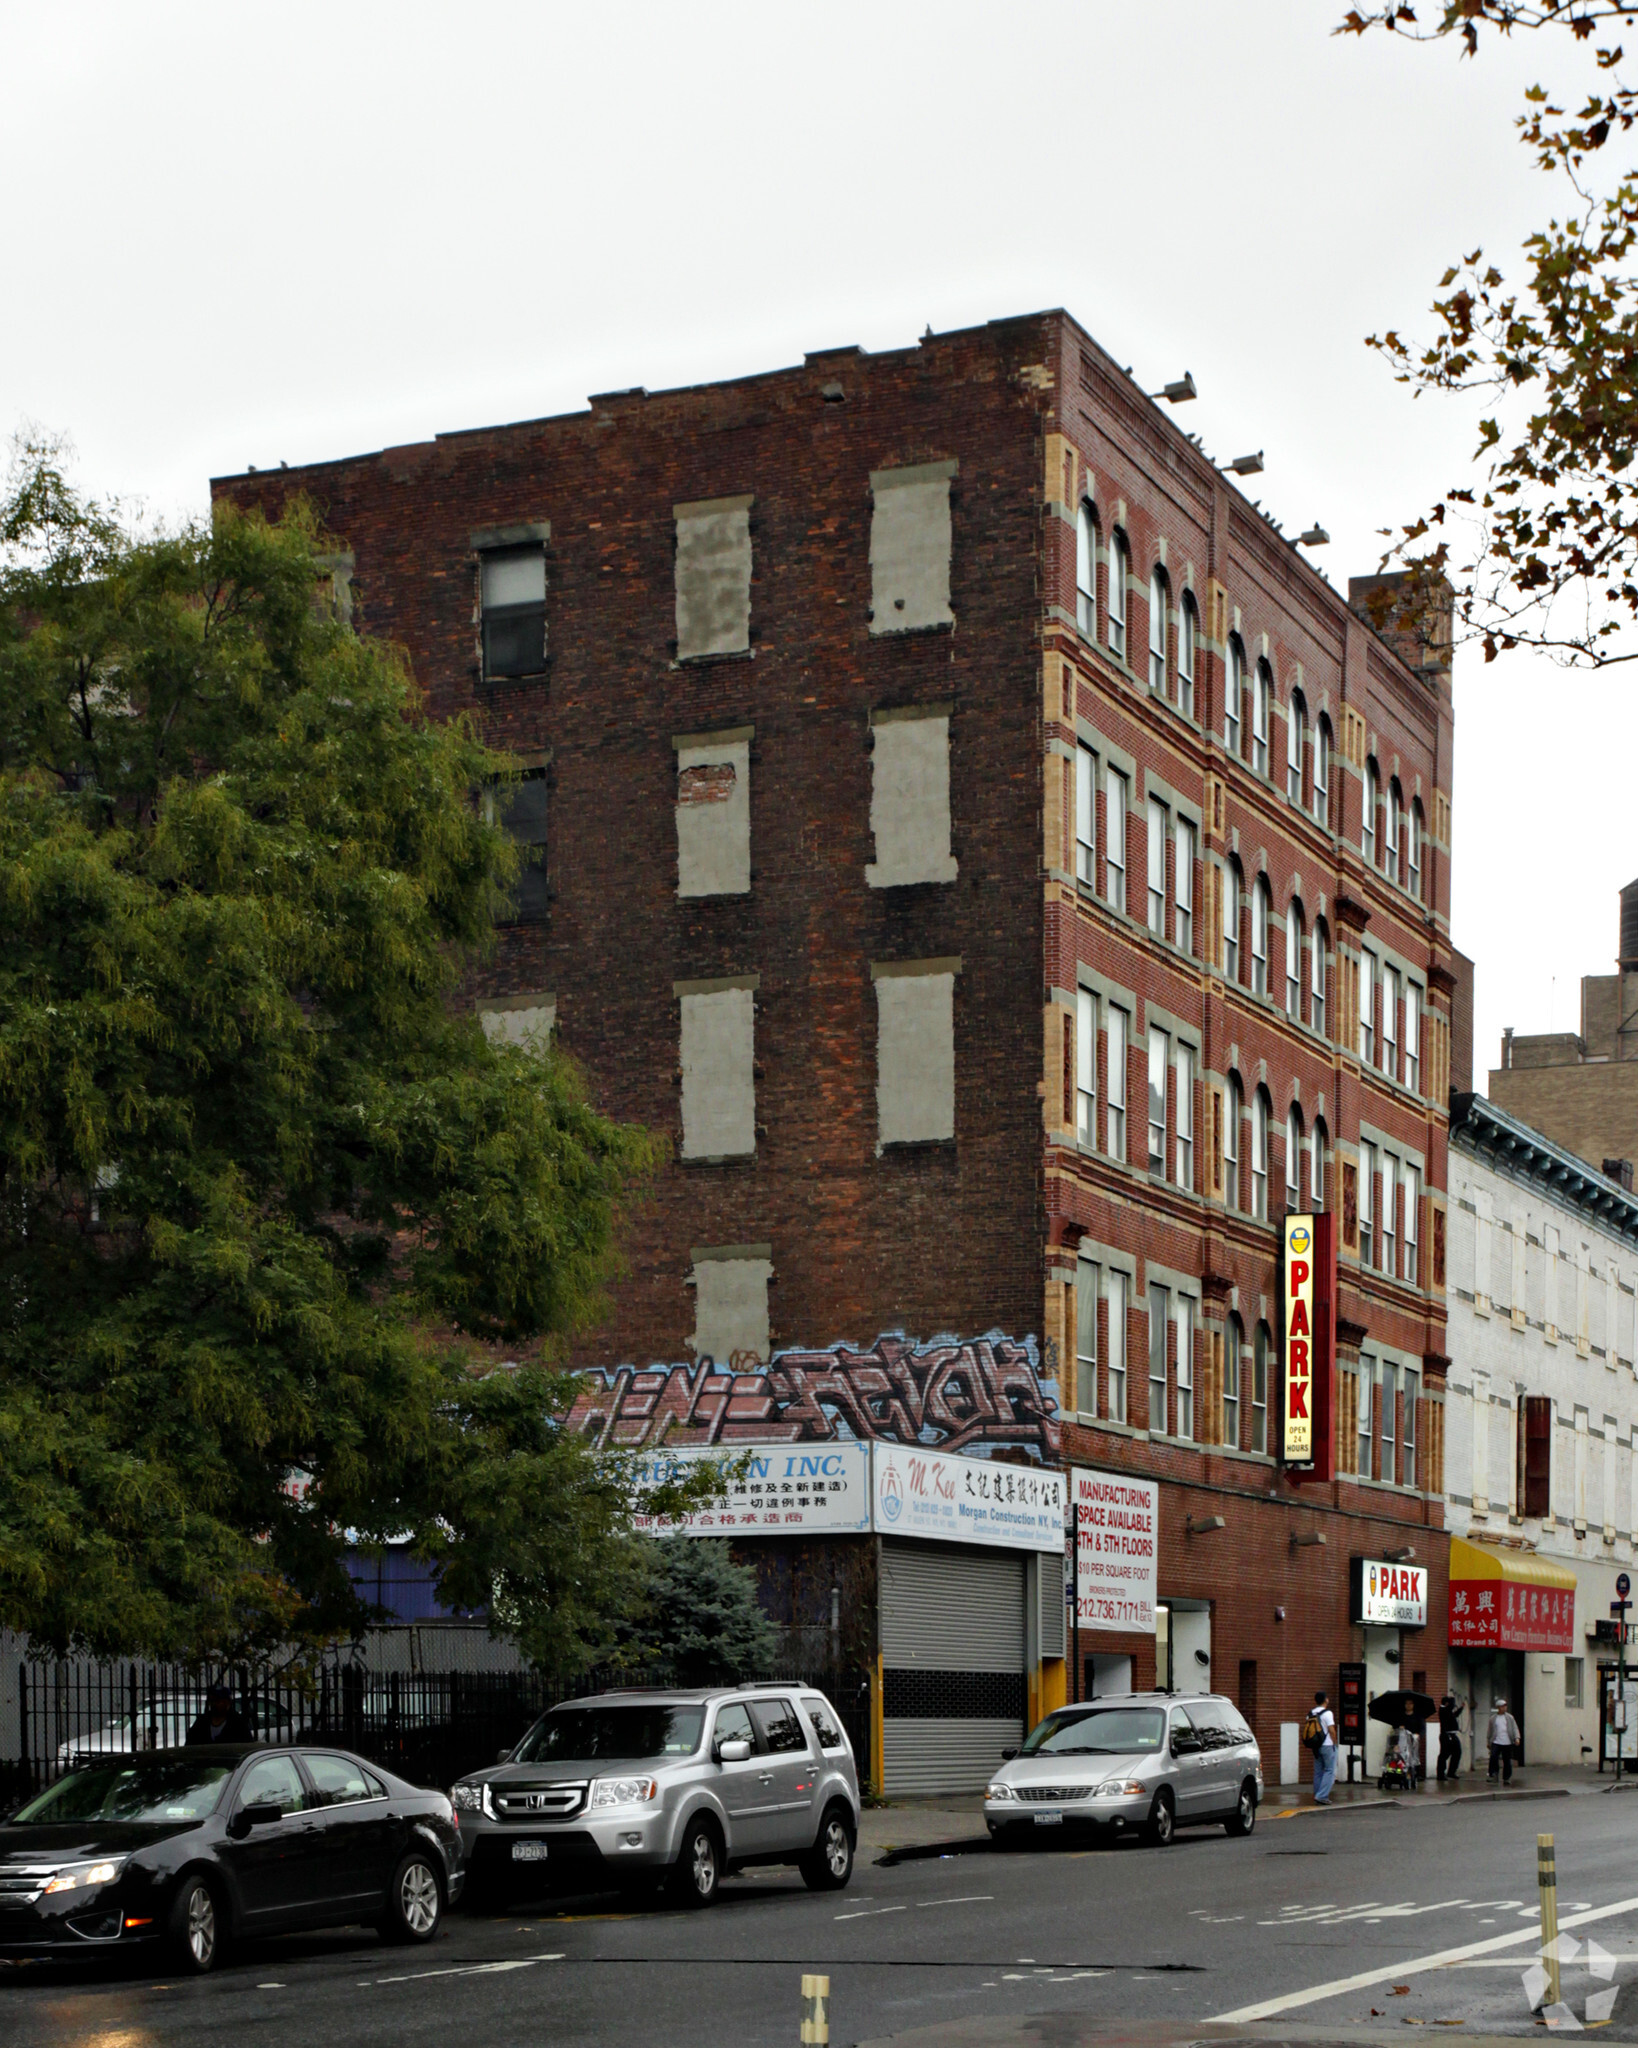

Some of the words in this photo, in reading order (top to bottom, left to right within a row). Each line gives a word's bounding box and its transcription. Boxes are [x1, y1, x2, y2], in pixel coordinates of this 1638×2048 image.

[1289, 1260, 1309, 1419] PARK
[1289, 1426, 1306, 1434] OPEN
[1294, 1435, 1301, 1443] 24
[1287, 1443, 1308, 1452] HOURS
[783, 1455, 846, 1477] INC.
[908, 1457, 928, 1496] M.
[932, 1462, 955, 1500] Kee
[1079, 1480, 1150, 1509] MANUFACTURING
[959, 1503, 987, 1520] Morgan
[990, 1507, 1035, 1525] Construction
[1038, 1514, 1049, 1530] NY,
[1052, 1517, 1063, 1529] Inc.
[1078, 1504, 1105, 1527] SPACE
[1107, 1509, 1152, 1533] AVAILABLE
[1095, 1534, 1101, 1551] &
[1104, 1535, 1119, 1553] 5TH
[1122, 1538, 1152, 1557] FLOORS
[1079, 1561, 1090, 1575] $10
[1091, 1563, 1104, 1577] PER
[1106, 1565, 1132, 1579] SQUARE
[1133, 1568, 1150, 1580] FOOT
[1380, 1567, 1420, 1602] PARK
[1077, 1597, 1138, 1621] 212.736.7171
[1140, 1601, 1152, 1612] BILL
[1397, 1607, 1413, 1620] HOURS
[1452, 1589, 1496, 1615] 萬興
[1501, 1624, 1511, 1641] New
